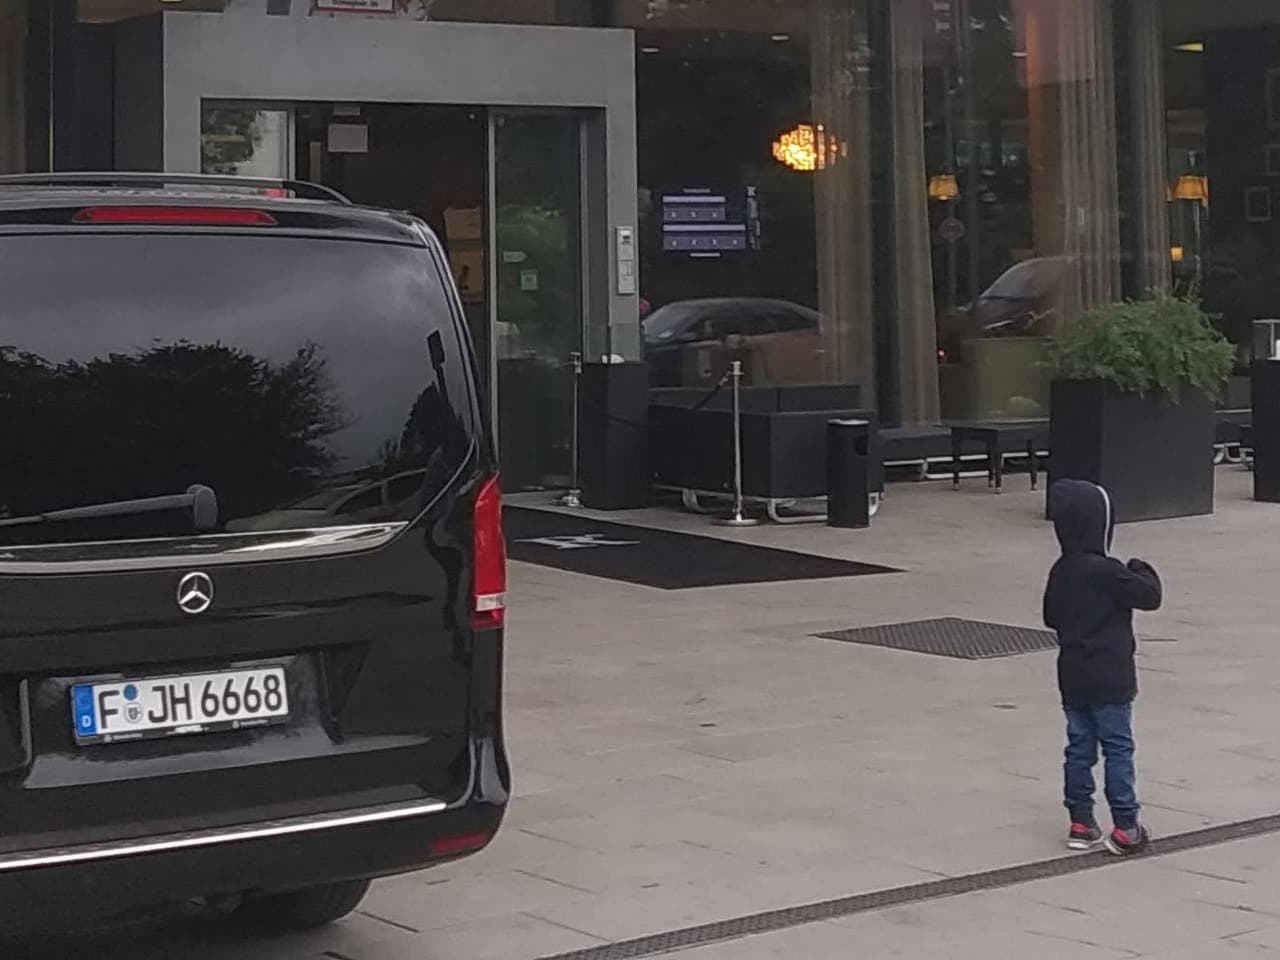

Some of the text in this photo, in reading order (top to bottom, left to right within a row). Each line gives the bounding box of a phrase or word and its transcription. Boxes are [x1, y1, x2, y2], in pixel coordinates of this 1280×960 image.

[98, 673, 284, 730] F JH 6668
